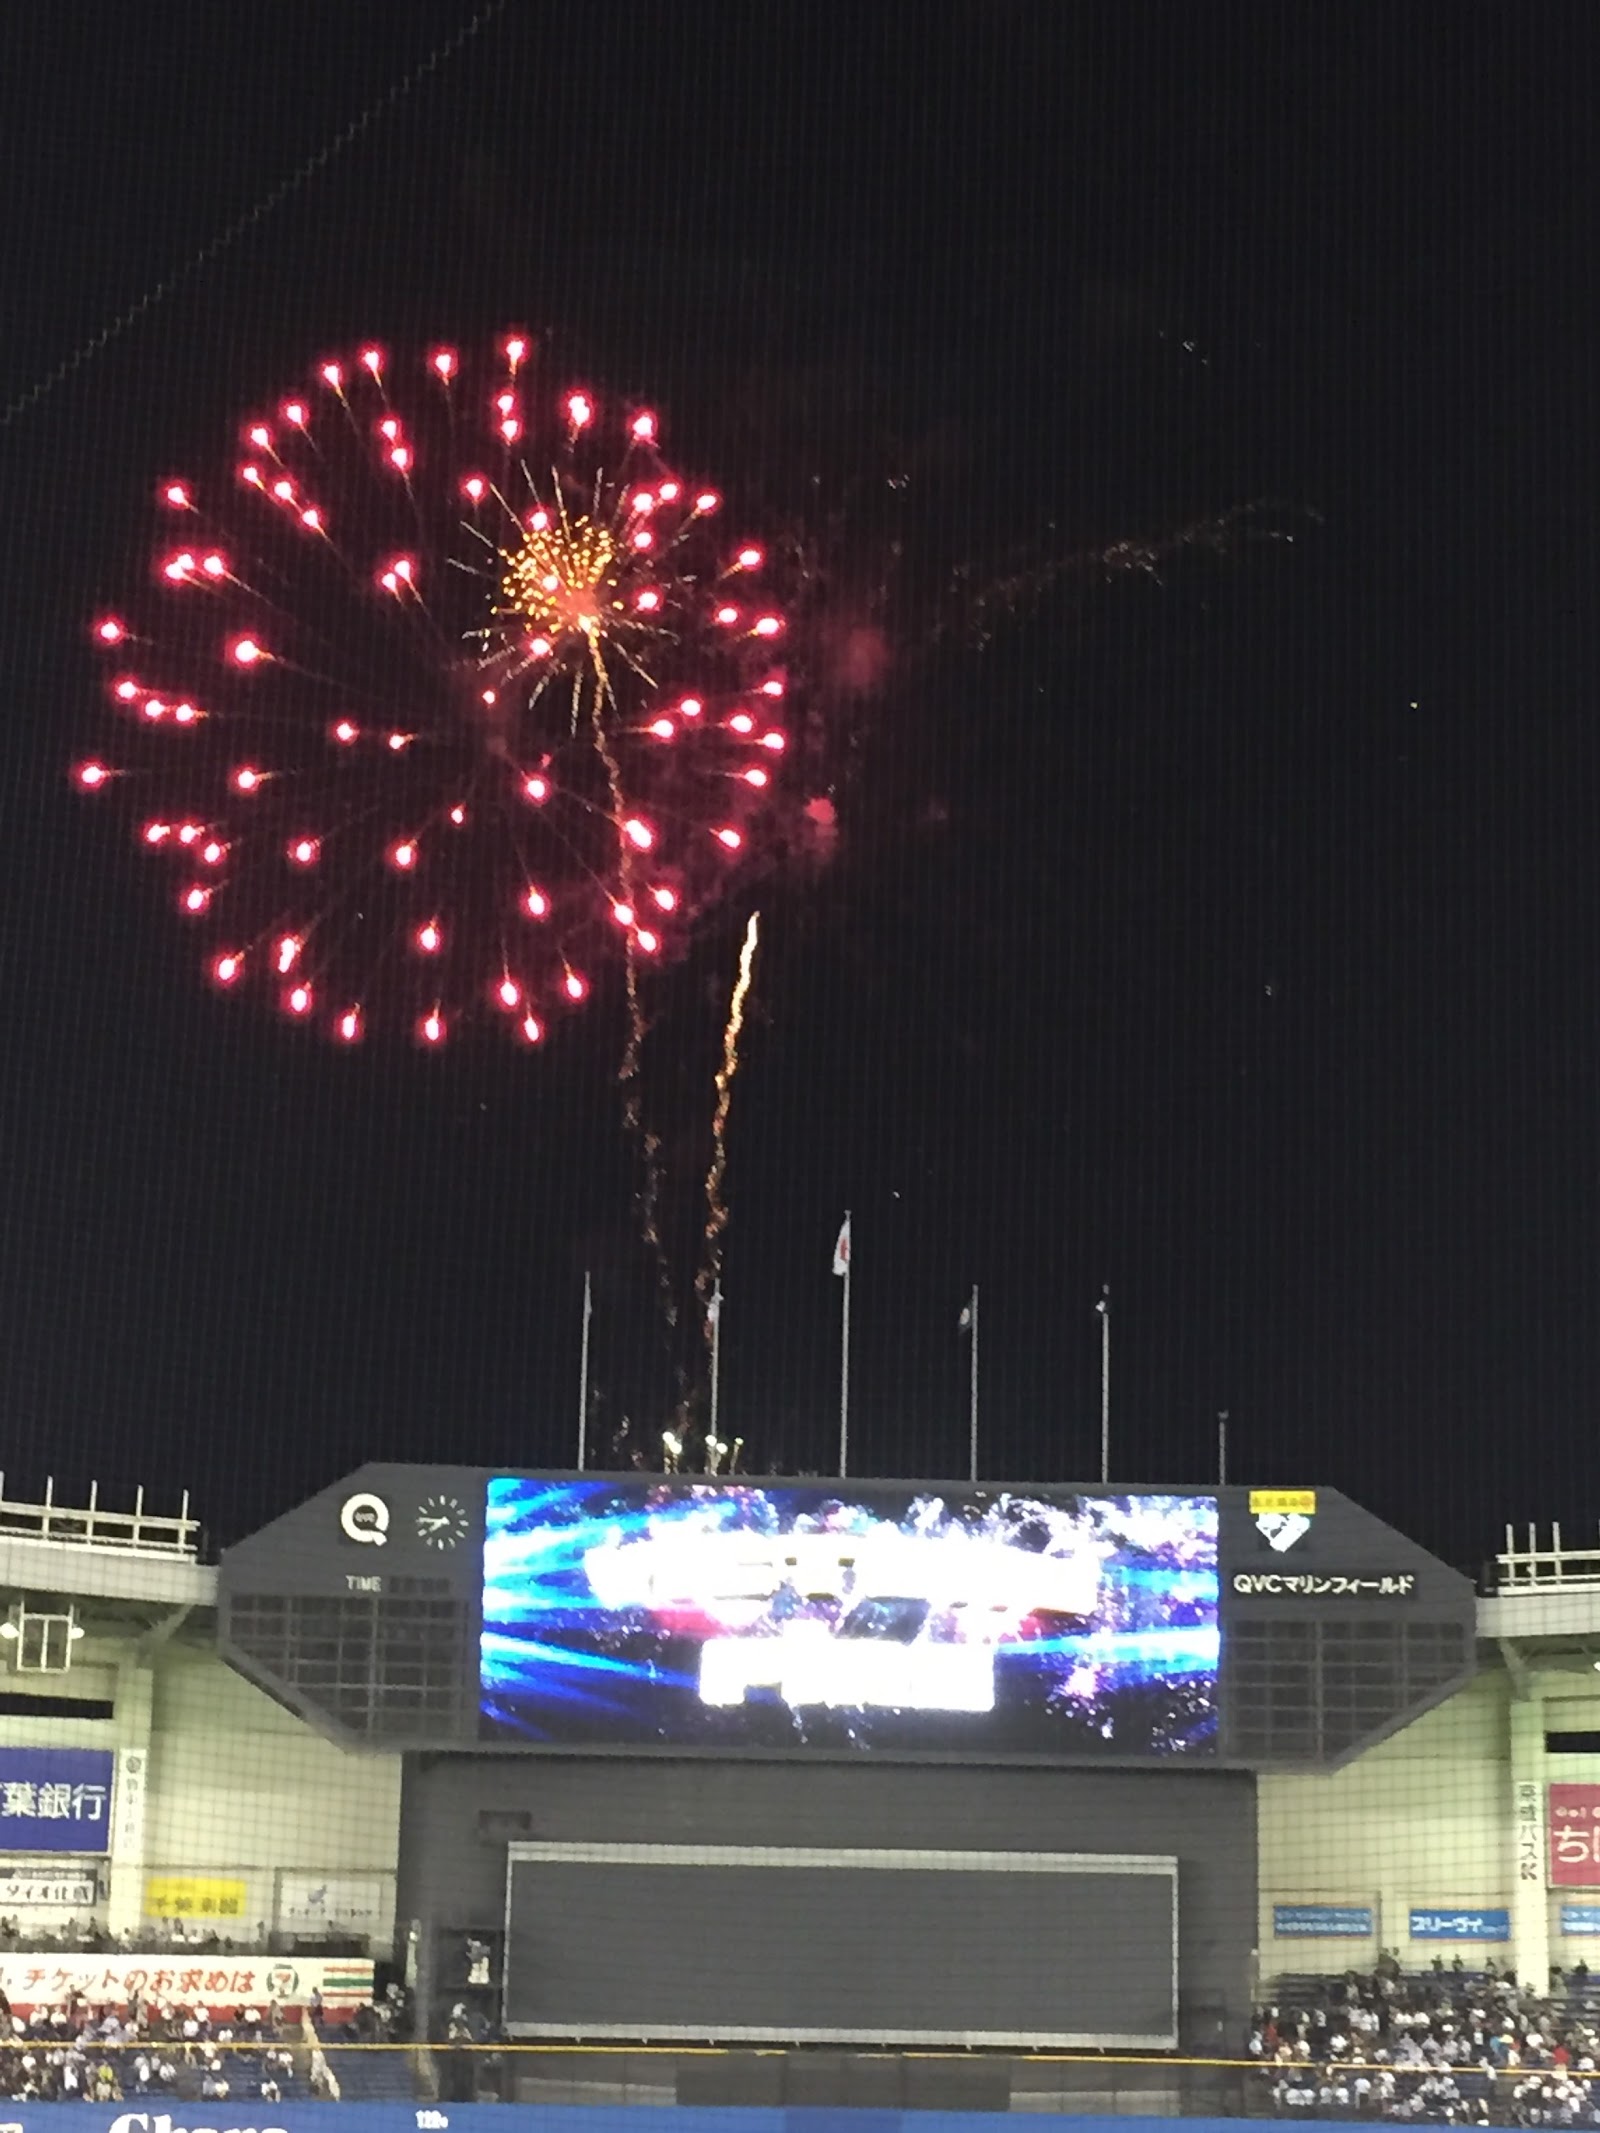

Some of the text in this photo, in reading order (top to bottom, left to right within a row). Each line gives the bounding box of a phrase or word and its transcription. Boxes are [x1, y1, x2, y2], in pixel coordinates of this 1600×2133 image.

[345, 1575, 382, 1592] TIME
[1233, 1574, 1415, 1595] QVCマリンフィールド
[0, 1780, 107, 1821] 葉銀行
[22, 1967, 256, 1994] チケットのお求めは
